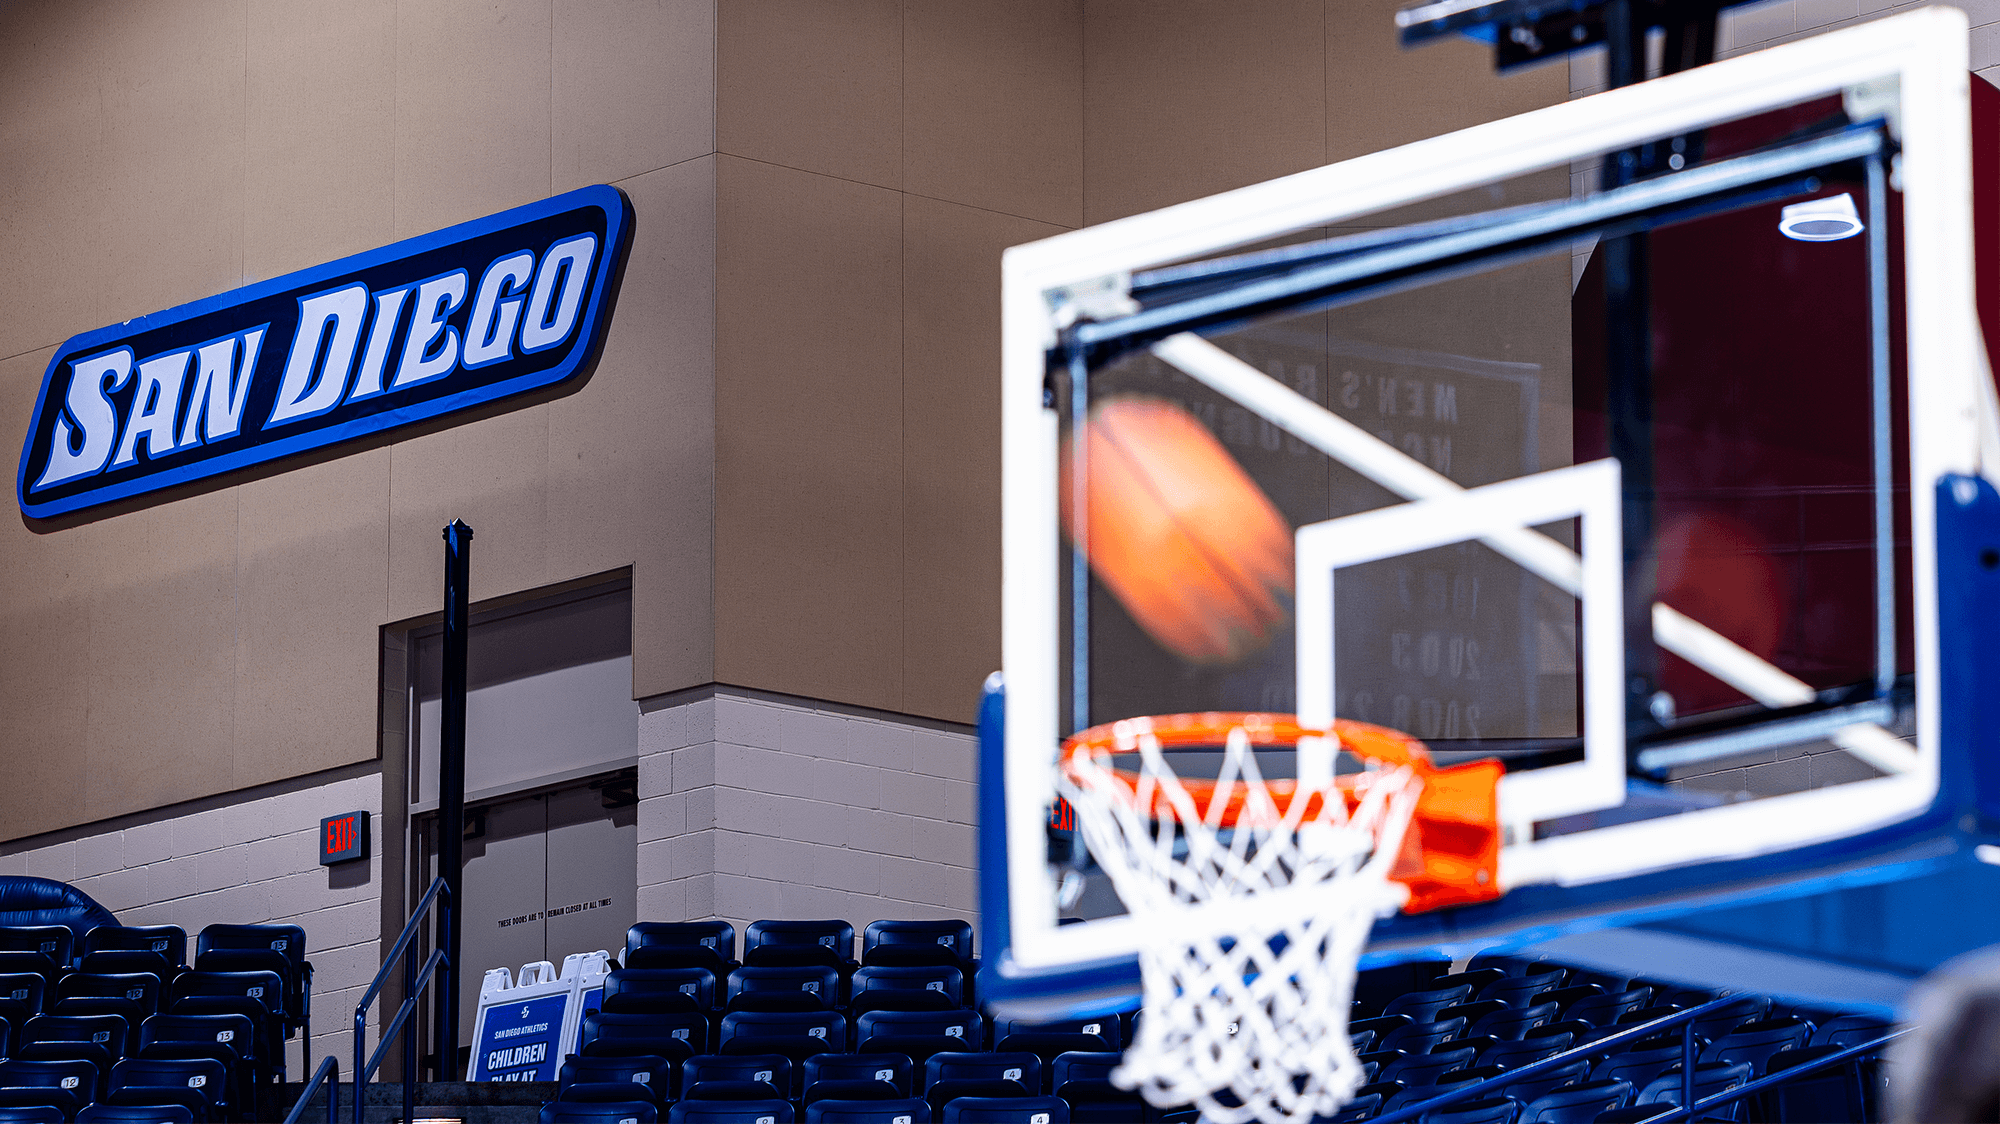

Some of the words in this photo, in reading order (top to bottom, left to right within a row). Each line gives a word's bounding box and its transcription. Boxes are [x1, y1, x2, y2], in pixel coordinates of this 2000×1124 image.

[36, 329, 266, 488] SAN
[269, 236, 596, 424] DIEGO
[327, 817, 354, 854] EXIT
[498, 919, 511, 928] THESE
[513, 915, 527, 925] DOORS
[528, 913, 537, 922] ARE
[538, 911, 544, 919] TO
[548, 907, 564, 917] REMAIN
[566, 904, 581, 914] CLOSED
[589, 900, 597, 909] ALL
[598, 898, 612, 907] TIMES
[274, 941, 284, 949] 13
[250, 988, 260, 997] 13
[494, 1030, 505, 1039] SAN
[505, 1027, 521, 1038] DIEGO
[521, 1022, 548, 1034] ATHLETICS
[96, 1032, 106, 1041] 12
[221, 1032, 230, 1041] 13
[487, 1042, 547, 1070] CHILDREN
[521, 1070, 537, 1082] AT
[65, 1078, 75, 1087] 12
[193, 1078, 202, 1086] 13
